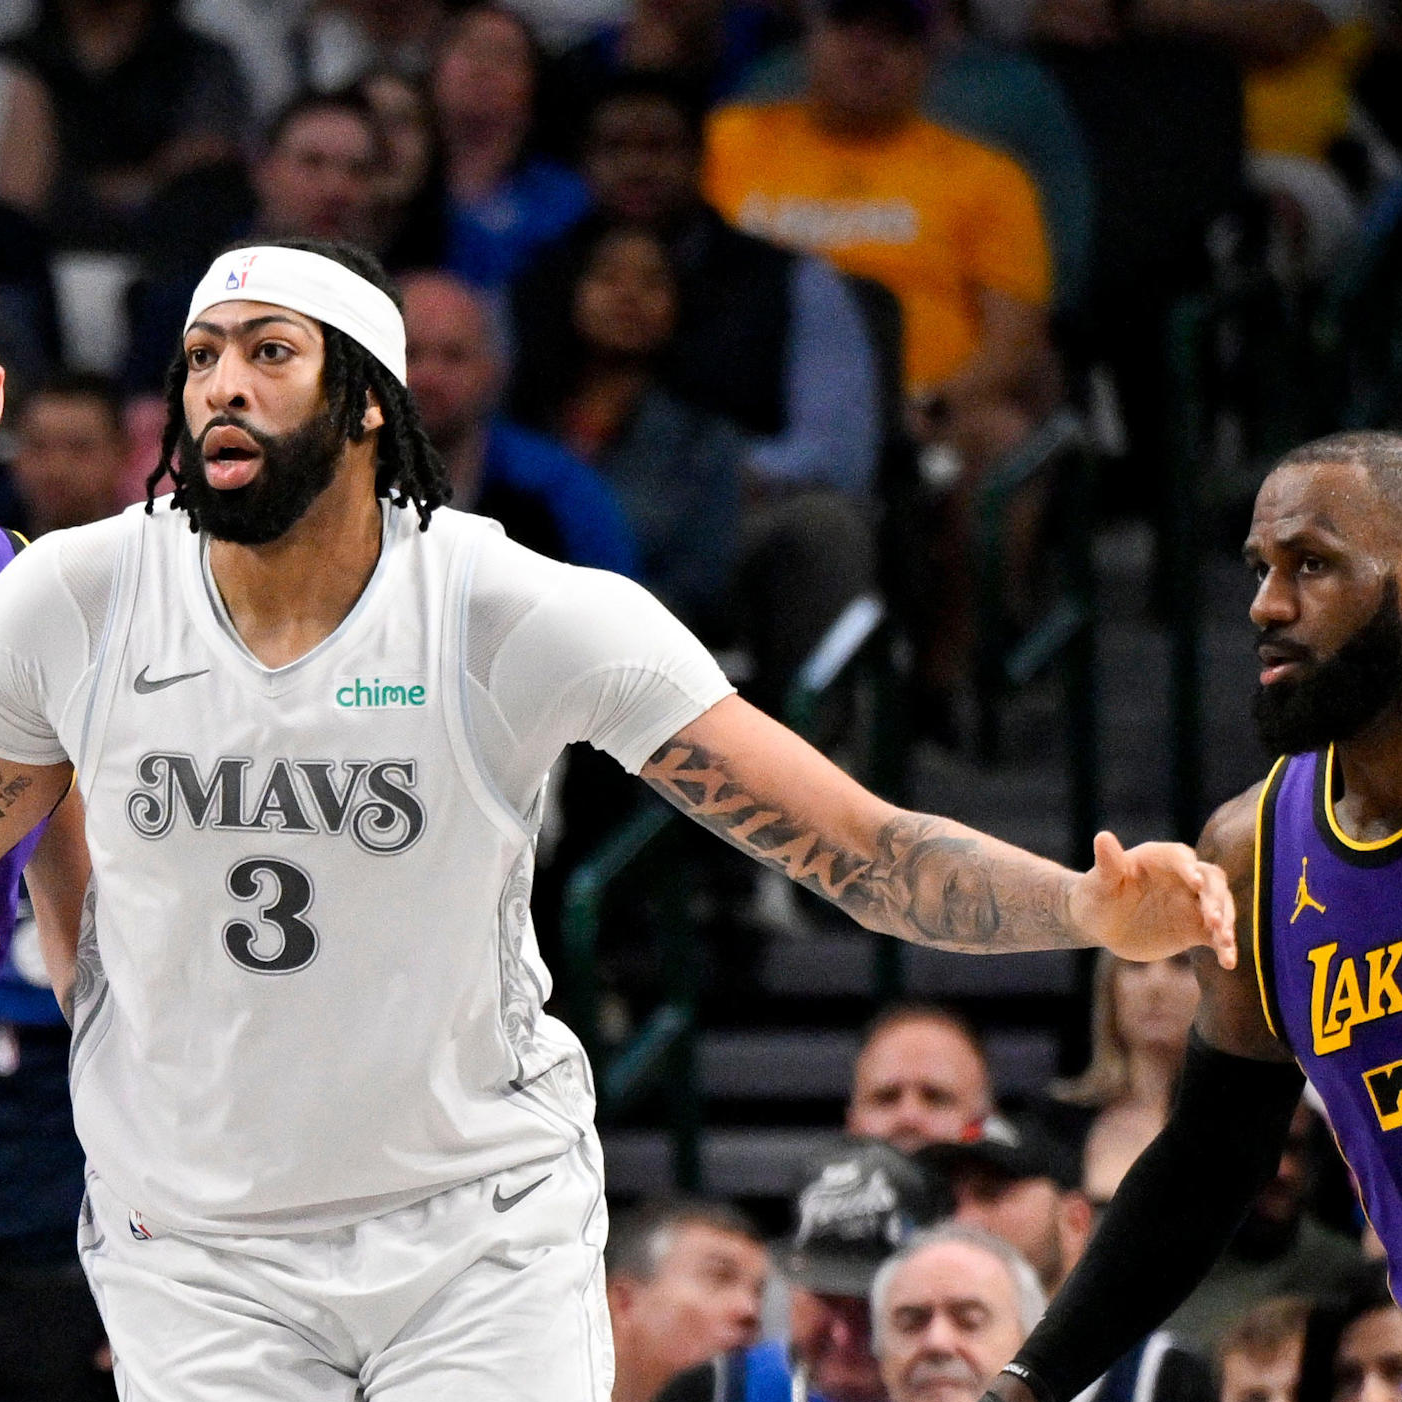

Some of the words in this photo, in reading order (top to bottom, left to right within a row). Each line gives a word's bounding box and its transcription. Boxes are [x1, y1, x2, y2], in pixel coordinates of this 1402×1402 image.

[335, 679, 426, 708] chime
[125, 751, 428, 857] MAVS
[221, 856, 319, 977] 3
